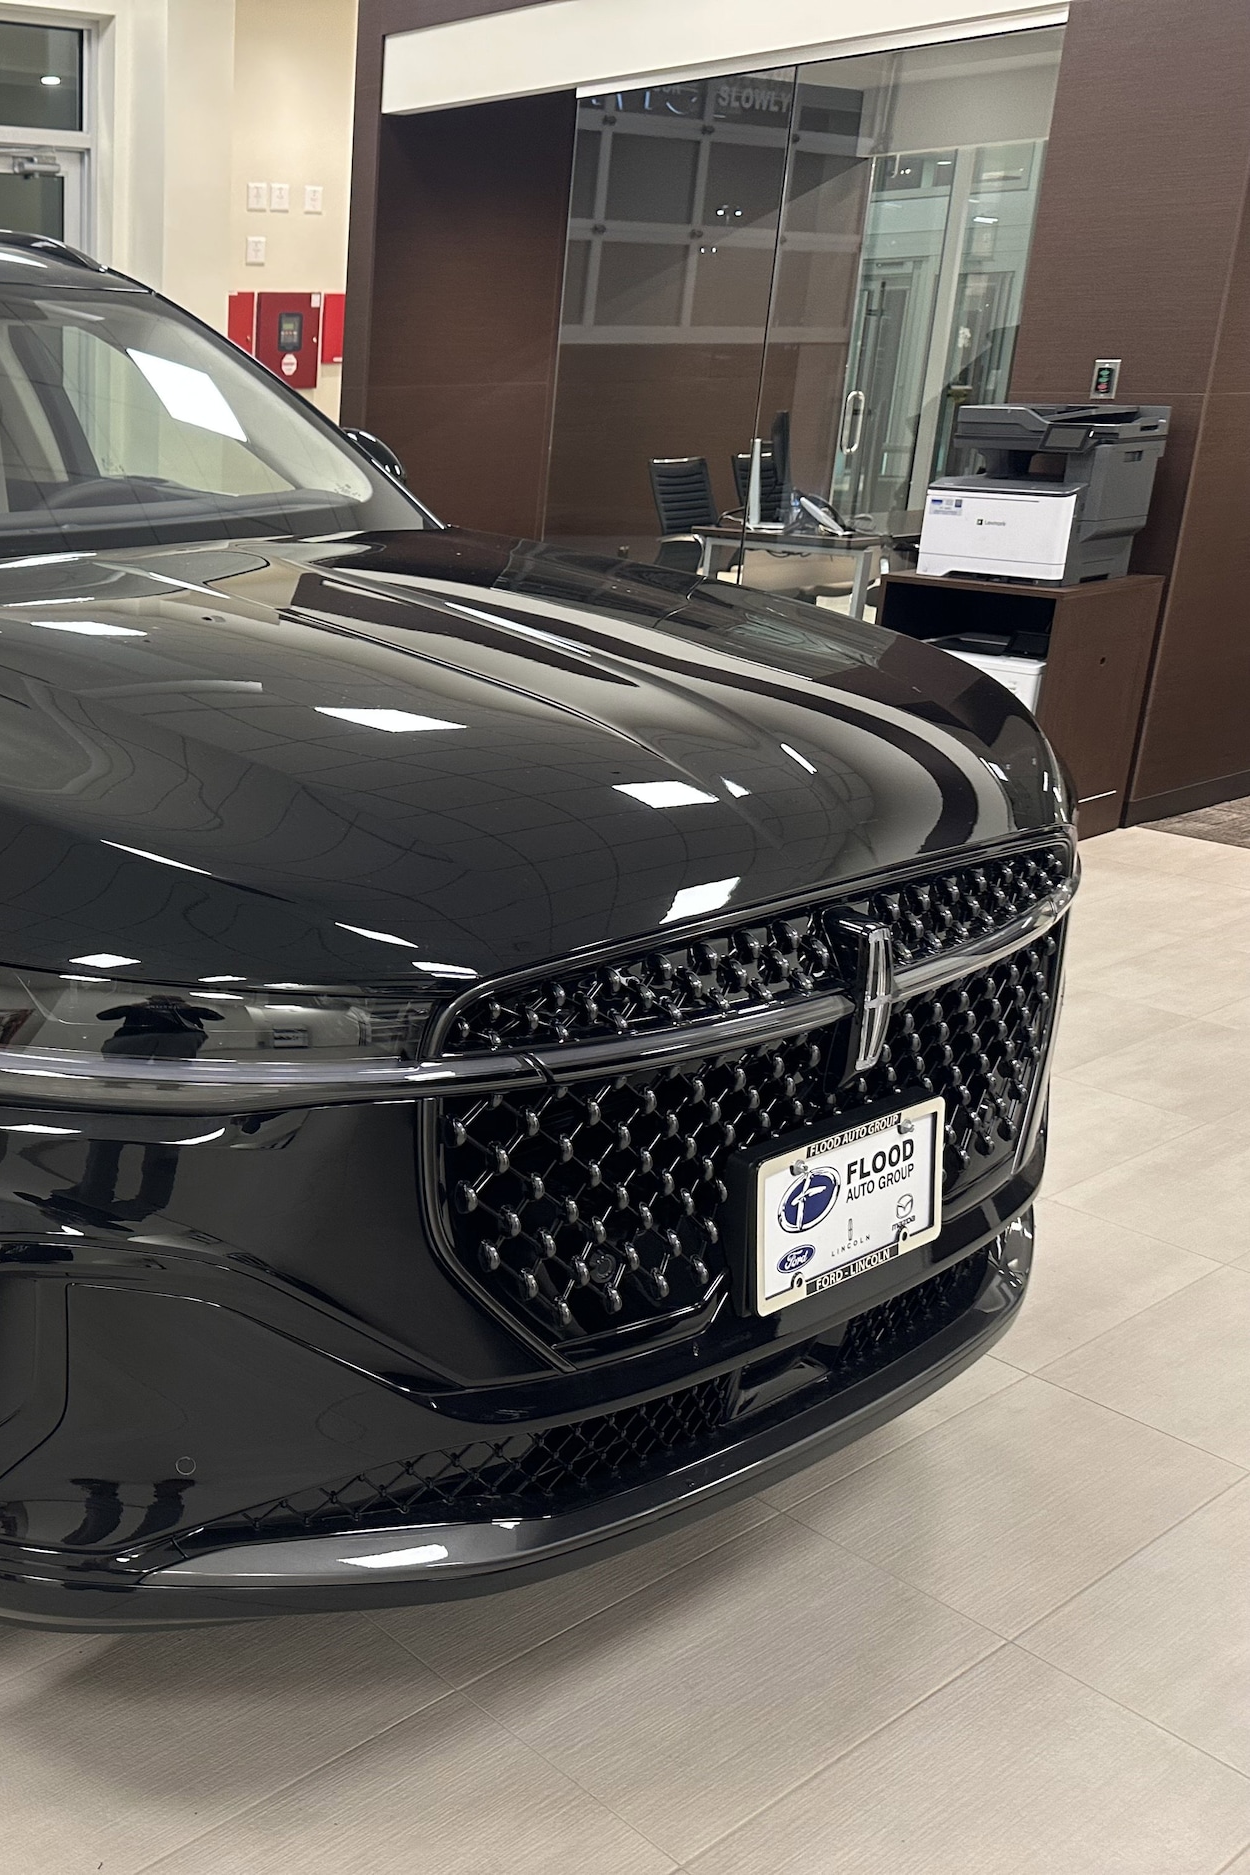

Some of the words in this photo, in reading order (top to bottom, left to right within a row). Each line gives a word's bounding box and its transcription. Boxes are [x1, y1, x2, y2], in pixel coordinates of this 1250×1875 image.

[718, 85, 792, 113] SLOWLY
[810, 1136, 841, 1157] FLOOD
[841, 1125, 869, 1146] AUTO
[868, 1115, 899, 1136] GROUP
[846, 1139, 915, 1185] FLOOD
[846, 1180, 875, 1204] AUTO
[879, 1163, 915, 1191] GROUP
[785, 1250, 810, 1270] Ford
[831, 1235, 871, 1257] LINCOLN
[816, 1268, 844, 1291] FORD
[850, 1249, 891, 1276] LINCOLN
